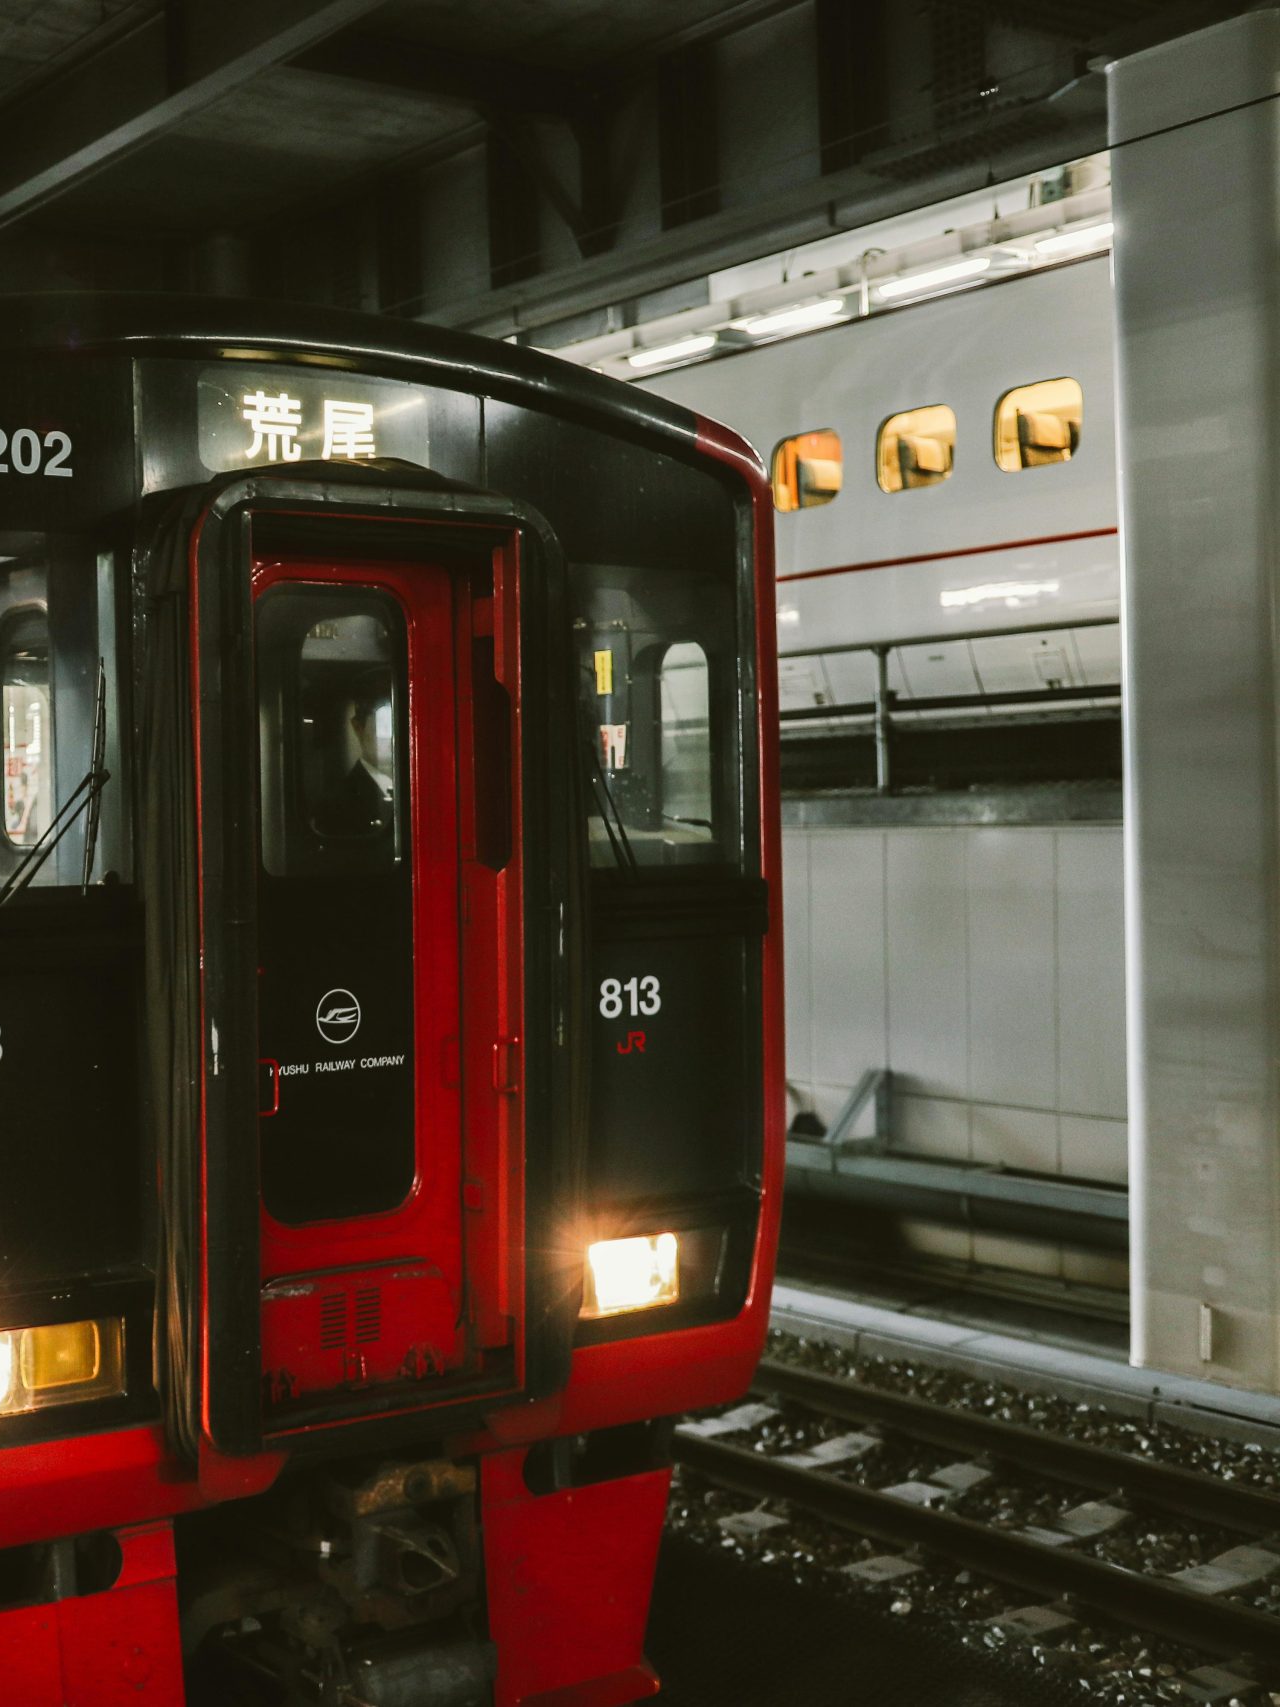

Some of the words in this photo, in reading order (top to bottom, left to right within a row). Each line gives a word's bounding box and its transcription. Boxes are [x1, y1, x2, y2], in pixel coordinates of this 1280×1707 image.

[242, 390, 377, 462] 荒尾
[599, 974, 662, 1019] 813
[616, 1030, 647, 1055] JR
[315, 1058, 357, 1073] RAILWAY
[360, 1054, 406, 1070] COMPANY
